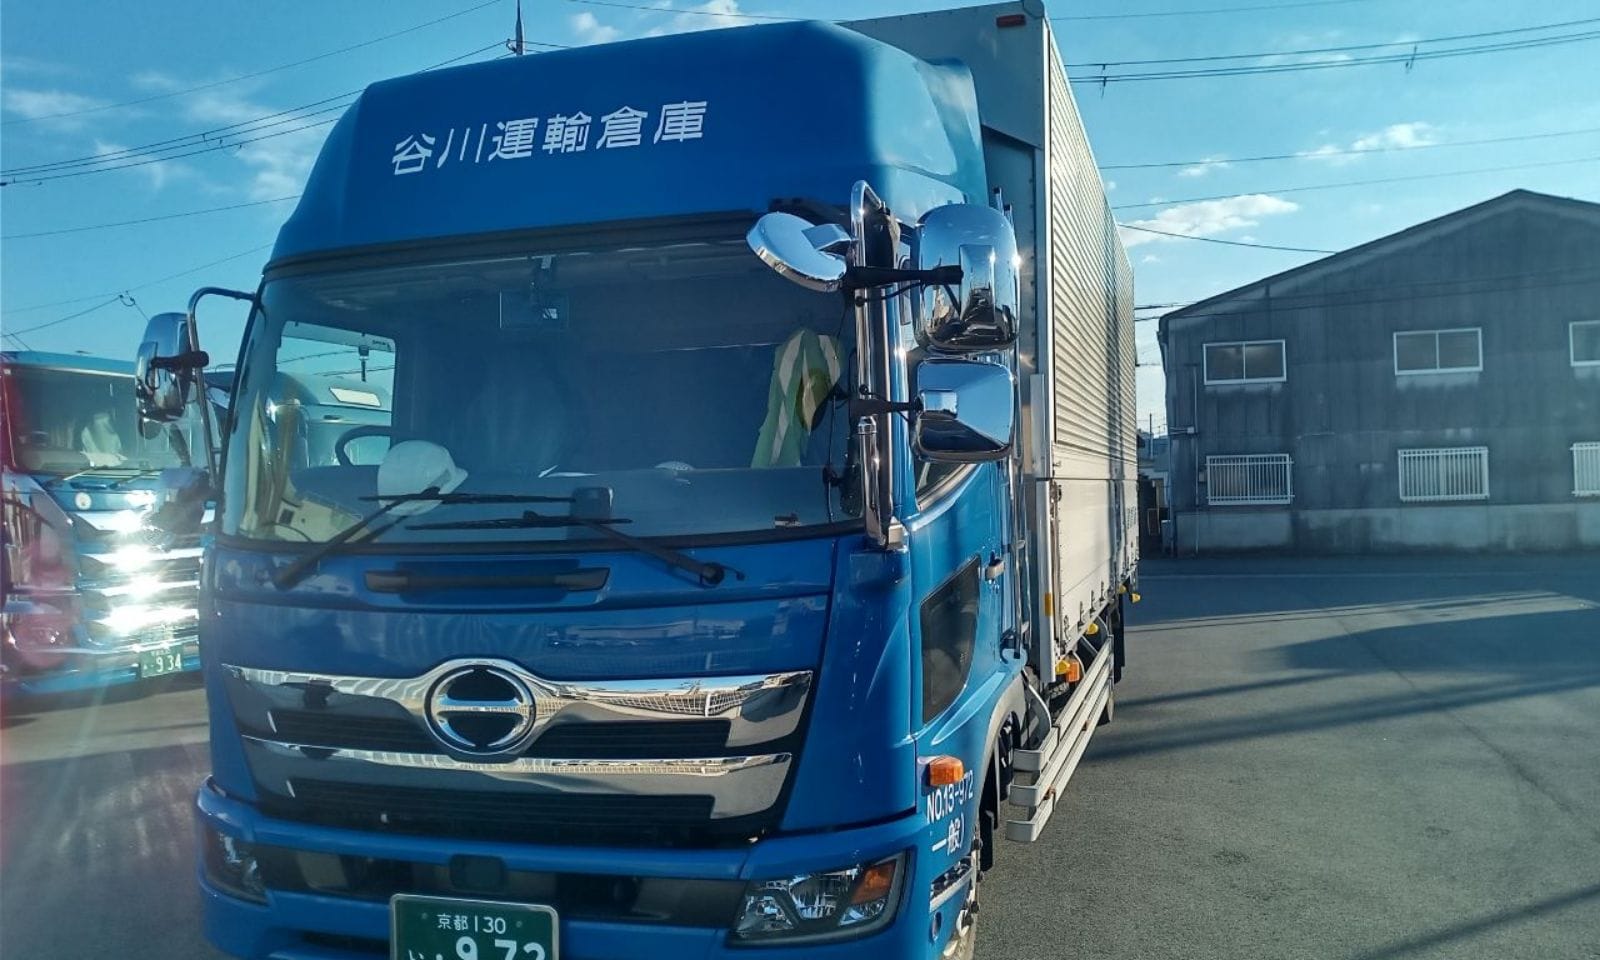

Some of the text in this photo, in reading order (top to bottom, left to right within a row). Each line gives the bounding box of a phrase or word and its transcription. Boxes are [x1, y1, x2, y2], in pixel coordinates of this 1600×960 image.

[391, 100, 707, 175] 谷川運輸倉庫
